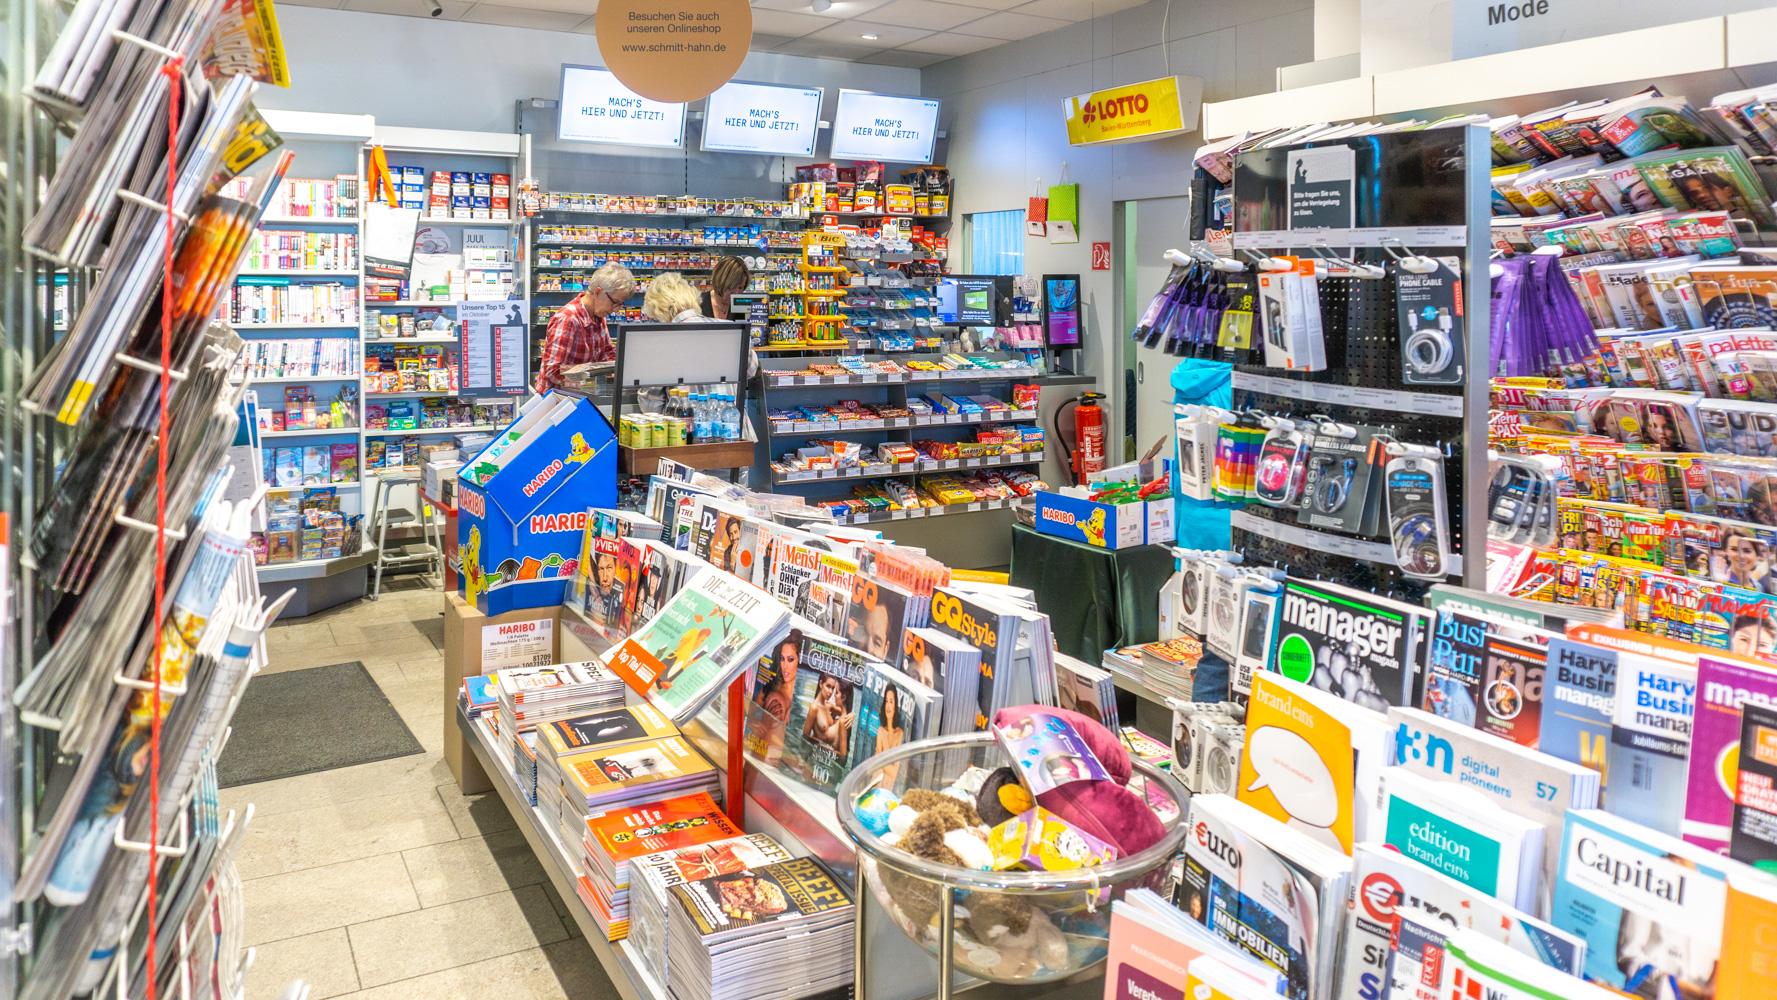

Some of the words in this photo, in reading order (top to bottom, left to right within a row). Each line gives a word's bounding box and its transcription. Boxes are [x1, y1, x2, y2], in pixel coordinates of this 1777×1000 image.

[628, 11, 676, 21] Besuchen
[678, 11, 693, 21] Sie
[696, 11, 720, 21] auch
[1488, 0, 1549, 26] Mode
[626, 25, 665, 33] unseren
[667, 24, 721, 35] Onlineshop
[621, 43, 727, 53] www.schmitt-hahn.de
[581, 106, 606, 117] HIER
[609, 109, 628, 119] UND
[630, 110, 665, 121] JETZT!
[608, 97, 643, 108] MACH'S
[749, 108, 780, 119] MACH'S
[1097, 93, 1149, 120] LOTTO
[725, 117, 747, 127] HIER
[750, 119, 766, 129] UND
[768, 121, 799, 131] JETZT!
[852, 127, 873, 137] HIER
[874, 129, 890, 138] UND
[891, 130, 920, 140] JETZT!
[874, 118, 903, 129] MACH'S
[1301, 199, 1309, 207] die
[1320, 190, 1328, 198] Sie
[1400, 279, 1421, 287] PHONE
[1422, 278, 1443, 286] CABLE
[1708, 333, 1776, 357] palette
[523, 459, 563, 497] HARIBO
[459, 485, 485, 519] HARIBO
[681, 508, 694, 518] THE
[1042, 507, 1075, 526] HARIBO
[1633, 533, 1660, 545] uns
[780, 563, 811, 579] Schlanker
[780, 572, 799, 586] OHNE
[702, 575, 727, 595] DIE
[727, 590, 761, 614] ZEIT
[778, 582, 795, 598] Diät
[852, 576, 878, 613] GQ
[499, 622, 536, 635] HARIBO
[931, 591, 963, 631] GQ
[962, 612, 996, 649] Style
[1282, 594, 1402, 658] manager
[1436, 612, 1487, 647] Busi
[904, 630, 925, 663] GQ
[616, 647, 630, 665] Top
[626, 655, 642, 673] Titel
[807, 648, 865, 686] GIRLS
[1239, 664, 1251, 674] USB
[1370, 653, 1399, 669] magazin
[1256, 682, 1292, 717] brand
[1292, 700, 1315, 729] eins
[812, 762, 830, 784] 100
[1459, 770, 1512, 798] pioneers
[1461, 756, 1500, 779] digital
[1535, 781, 1558, 801] 57
[707, 811, 736, 835] WISSEN
[744, 834, 789, 864] BEEF!
[1409, 819, 1471, 862] edition
[647, 853, 665, 868] 10
[1407, 838, 1443, 869] brand
[1443, 855, 1470, 882] eins
[1576, 836, 1687, 907] Capital
[766, 865, 794, 893] SPECIAL
[789, 890, 817, 913] ISSUE
[784, 859, 850, 911] BEEF!
[1213, 909, 1289, 970] IMMOBILIEN
[1423, 945, 1437, 986] FOCUS
